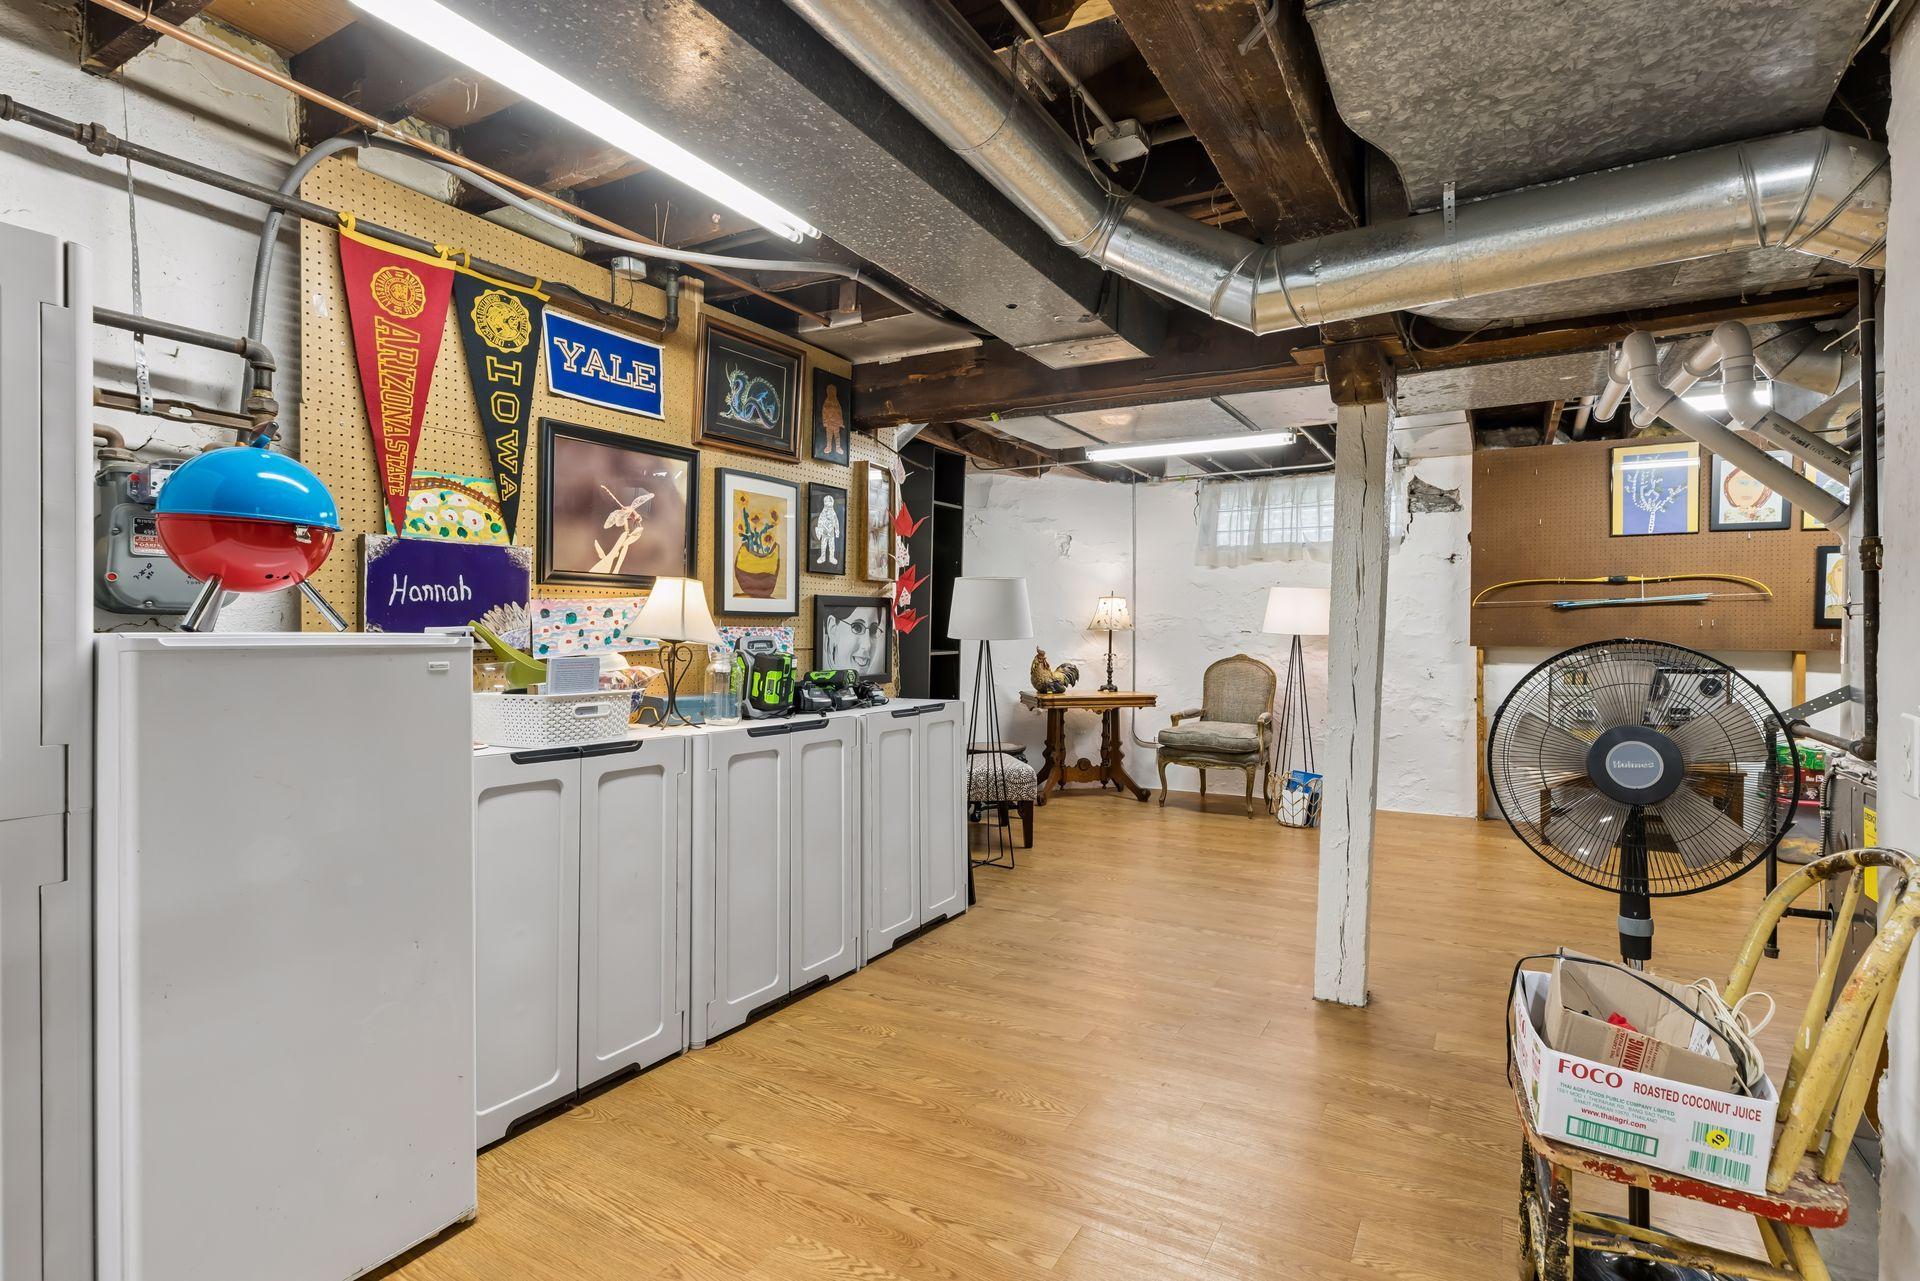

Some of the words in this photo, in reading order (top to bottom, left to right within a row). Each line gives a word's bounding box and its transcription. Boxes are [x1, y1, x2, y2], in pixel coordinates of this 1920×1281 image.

[374, 315, 421, 437] ARIZONA
[553, 336, 656, 394] YALE
[486, 356, 522, 501] IOWA
[384, 437, 410, 497] STATE
[388, 573, 472, 606] Hannah
[1622, 1038, 1645, 1071] ARNING
[1558, 1058, 1623, 1088] FOCO
[1633, 1081, 1679, 1102] ROASTED
[1682, 1093, 1731, 1115] COCONUT
[1733, 1105, 1762, 1121] JUICE
[1586, 1089, 1605, 1099] FOODS
[1605, 1094, 1625, 1104] PUBLIC
[1626, 1100, 1653, 1111] COMPANY
[1653, 1107, 1675, 1117] LIMITED
[1581, 1107, 1647, 1129] www.thaiagri.com
[1711, 1134, 1725, 1146] 19
